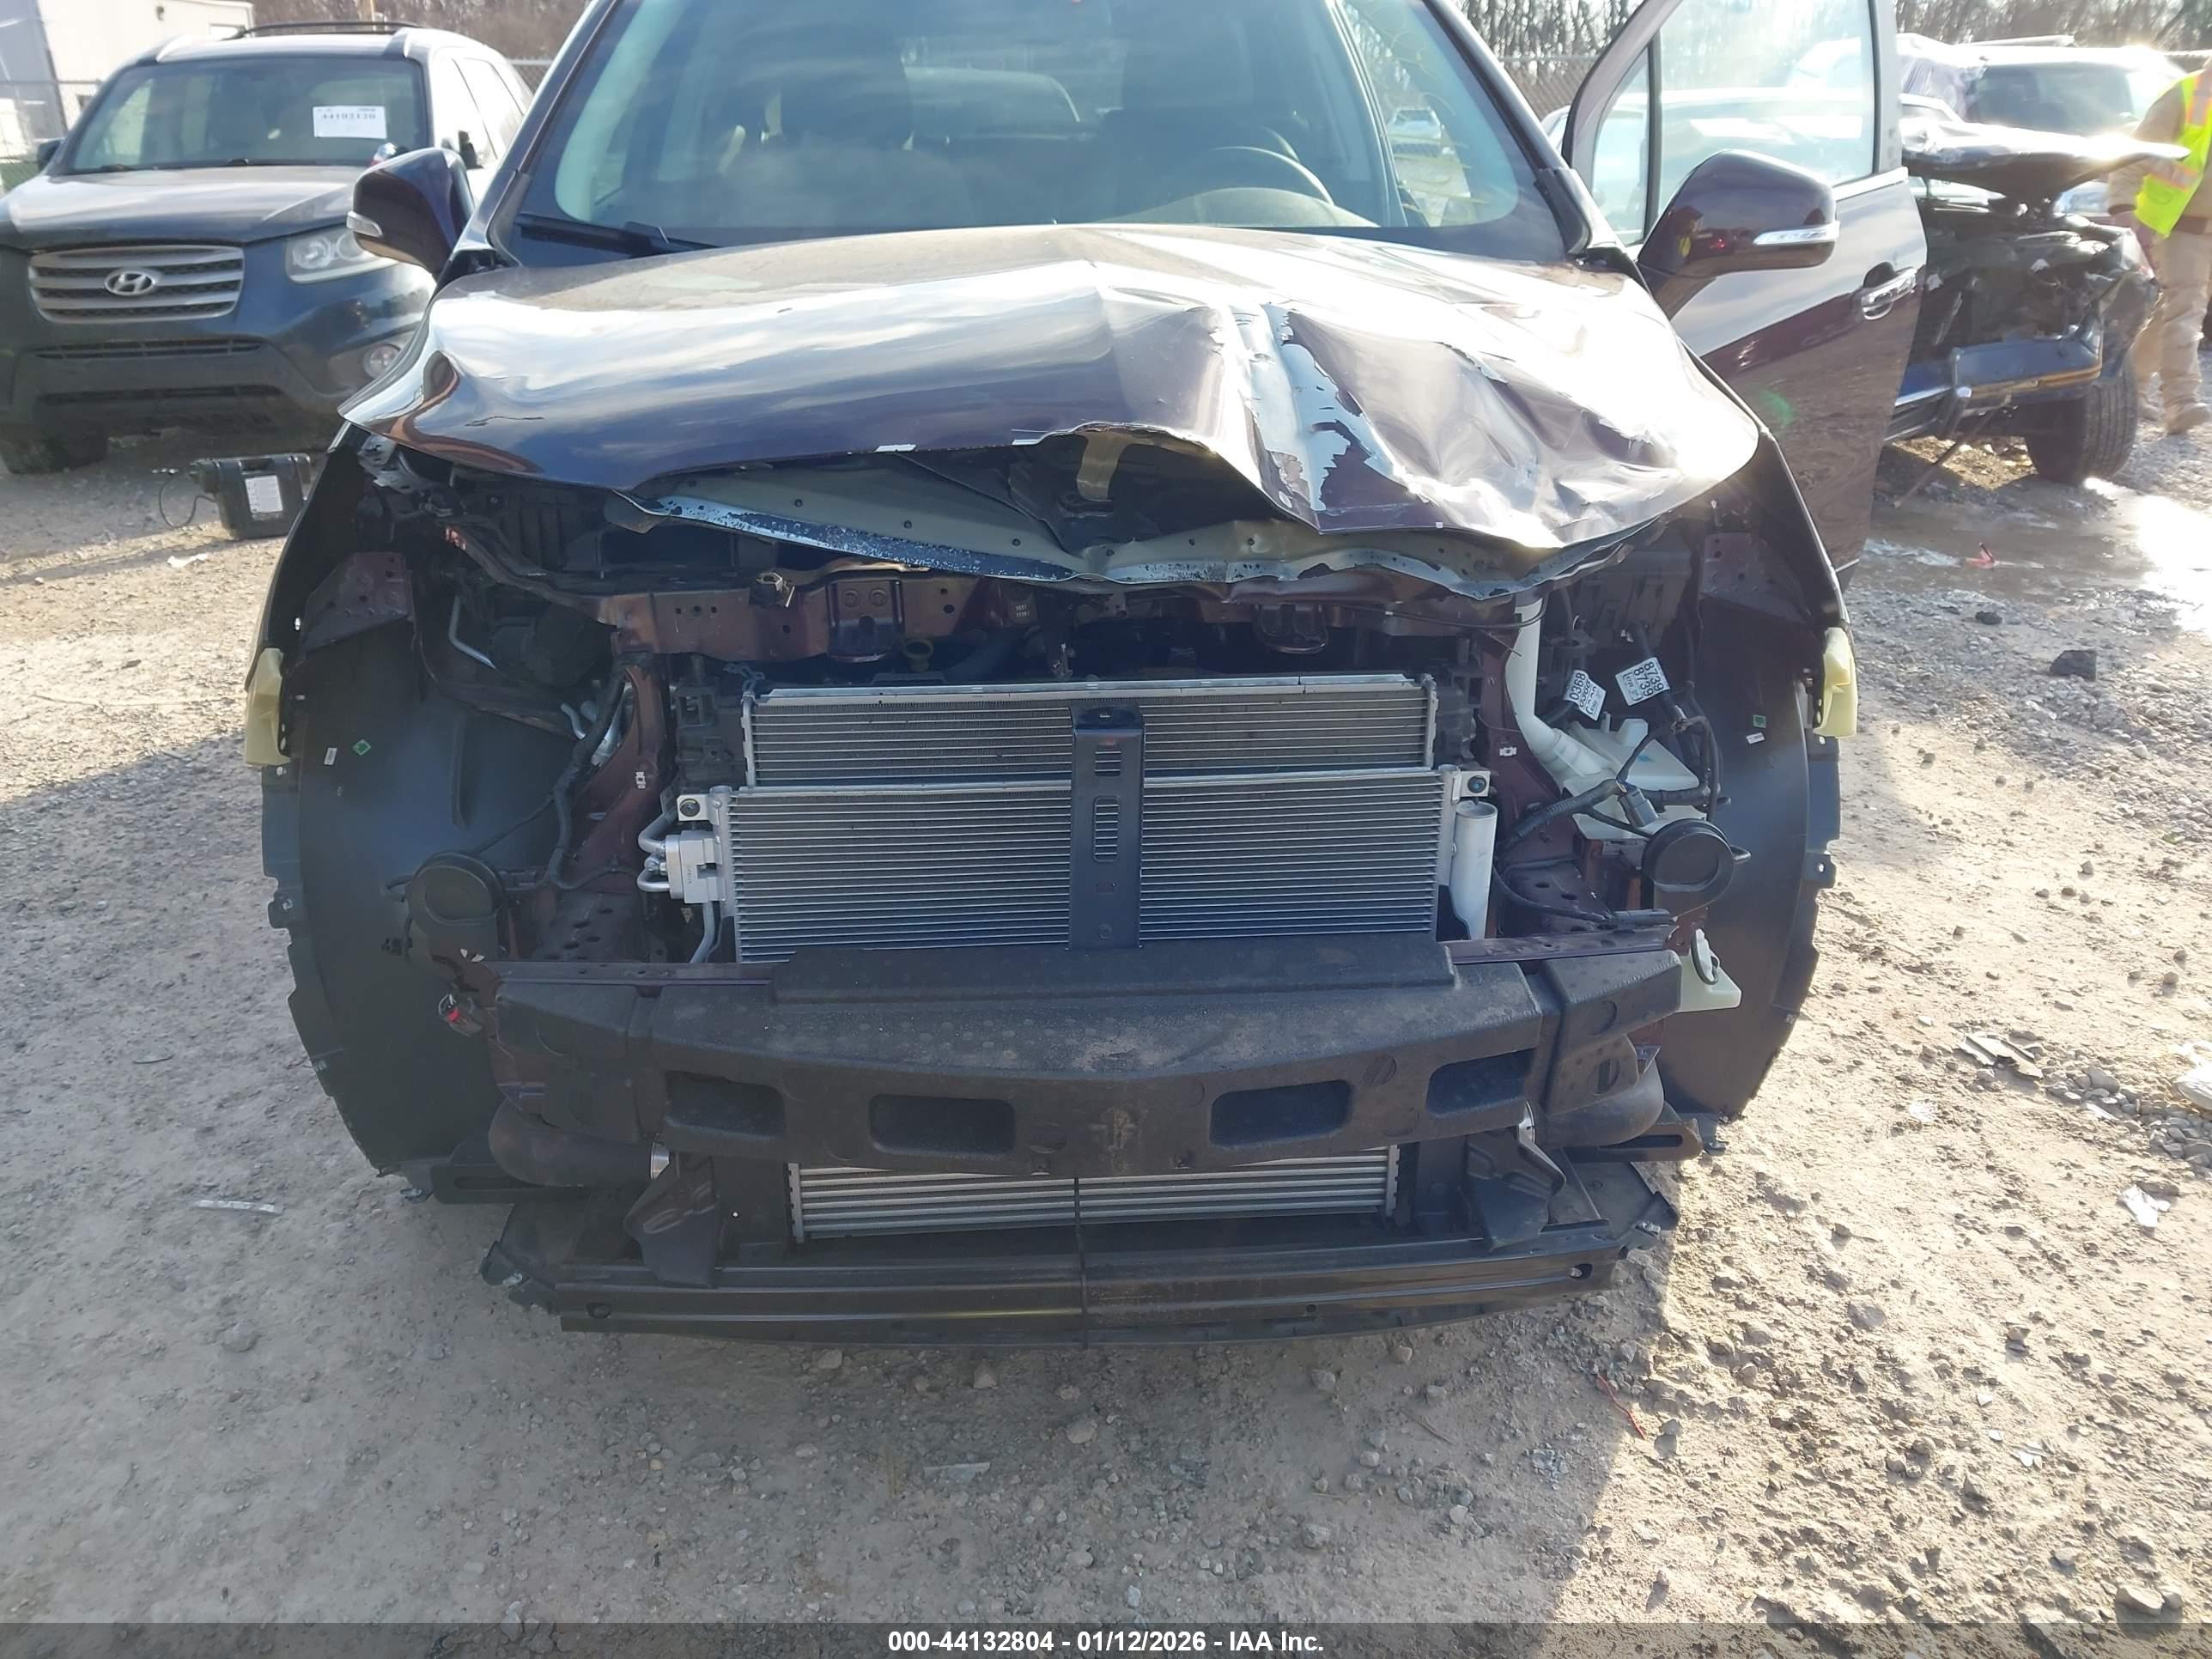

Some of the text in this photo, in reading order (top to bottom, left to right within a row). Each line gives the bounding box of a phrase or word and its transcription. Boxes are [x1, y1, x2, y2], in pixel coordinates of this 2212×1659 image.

[1569, 672, 1586, 701] 0368
[1633, 667, 1654, 696] 8739
[1644, 661, 1664, 691] 8739
